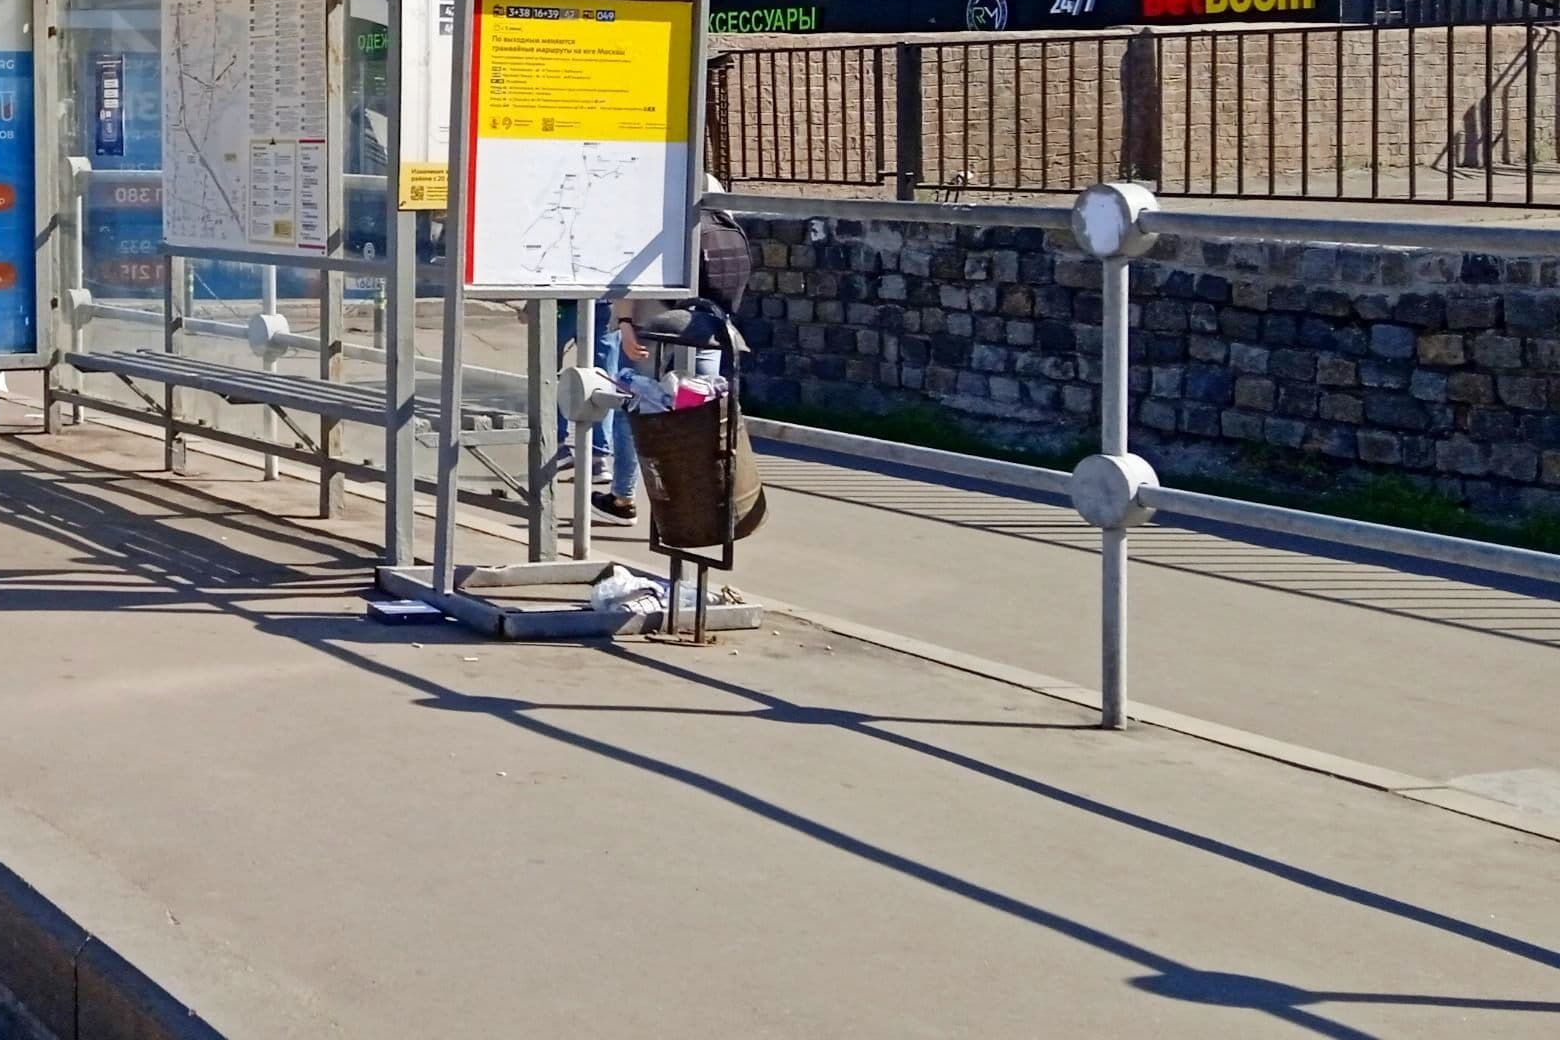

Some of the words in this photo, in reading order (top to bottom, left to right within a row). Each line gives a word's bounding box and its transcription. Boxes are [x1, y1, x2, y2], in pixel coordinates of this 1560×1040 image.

[508, 7, 531, 17] 3+38
[534, 8, 559, 19] 16+39
[596, 11, 614, 20] 049
